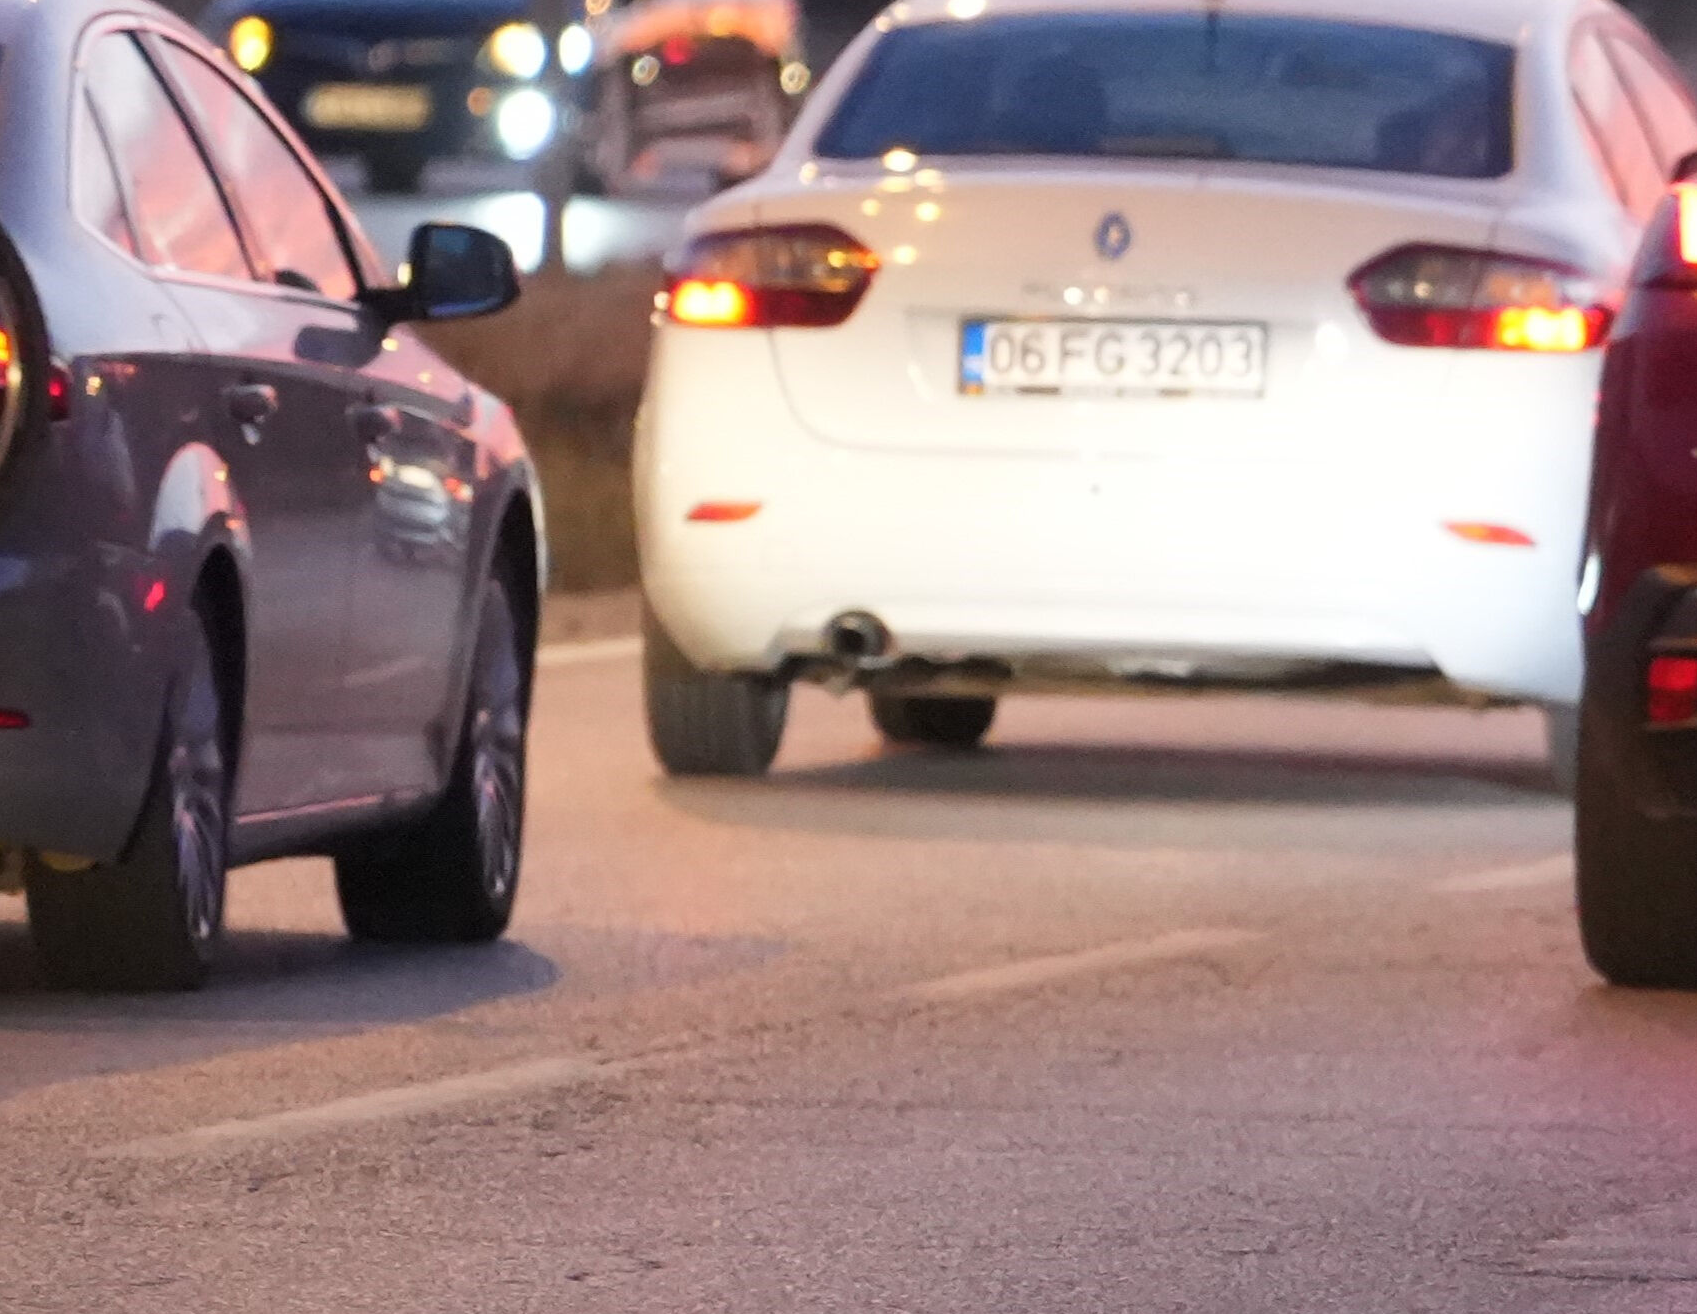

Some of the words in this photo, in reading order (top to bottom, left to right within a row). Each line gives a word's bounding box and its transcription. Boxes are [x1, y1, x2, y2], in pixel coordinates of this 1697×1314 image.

[990, 332, 1047, 376] 06
[1059, 330, 1125, 376] FG
[1137, 330, 1252, 377] 3203
